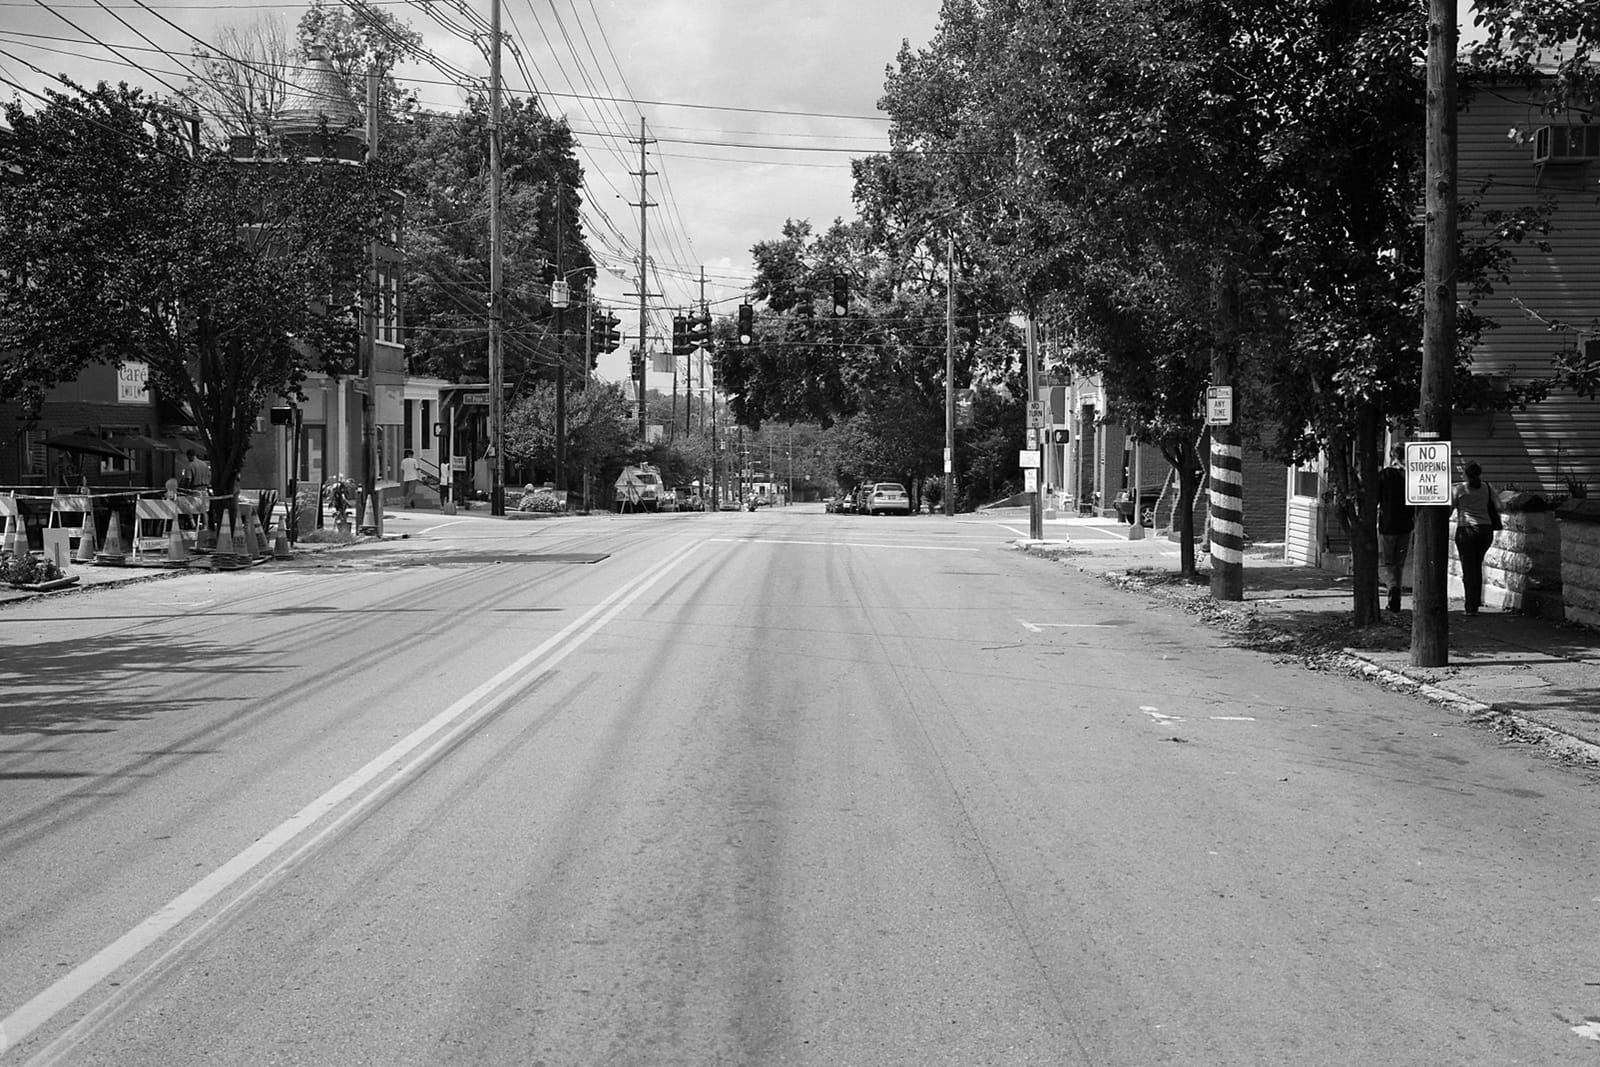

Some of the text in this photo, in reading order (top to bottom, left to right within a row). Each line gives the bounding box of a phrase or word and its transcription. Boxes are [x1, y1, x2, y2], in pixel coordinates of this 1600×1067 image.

[1214, 400, 1226, 408] ANY
[1214, 409, 1226, 417] TIME
[1419, 446, 1437, 460] NO
[1410, 461, 1447, 472] STOPPING
[1419, 473, 1438, 483] ANY
[1418, 485, 1439, 495] TIME
